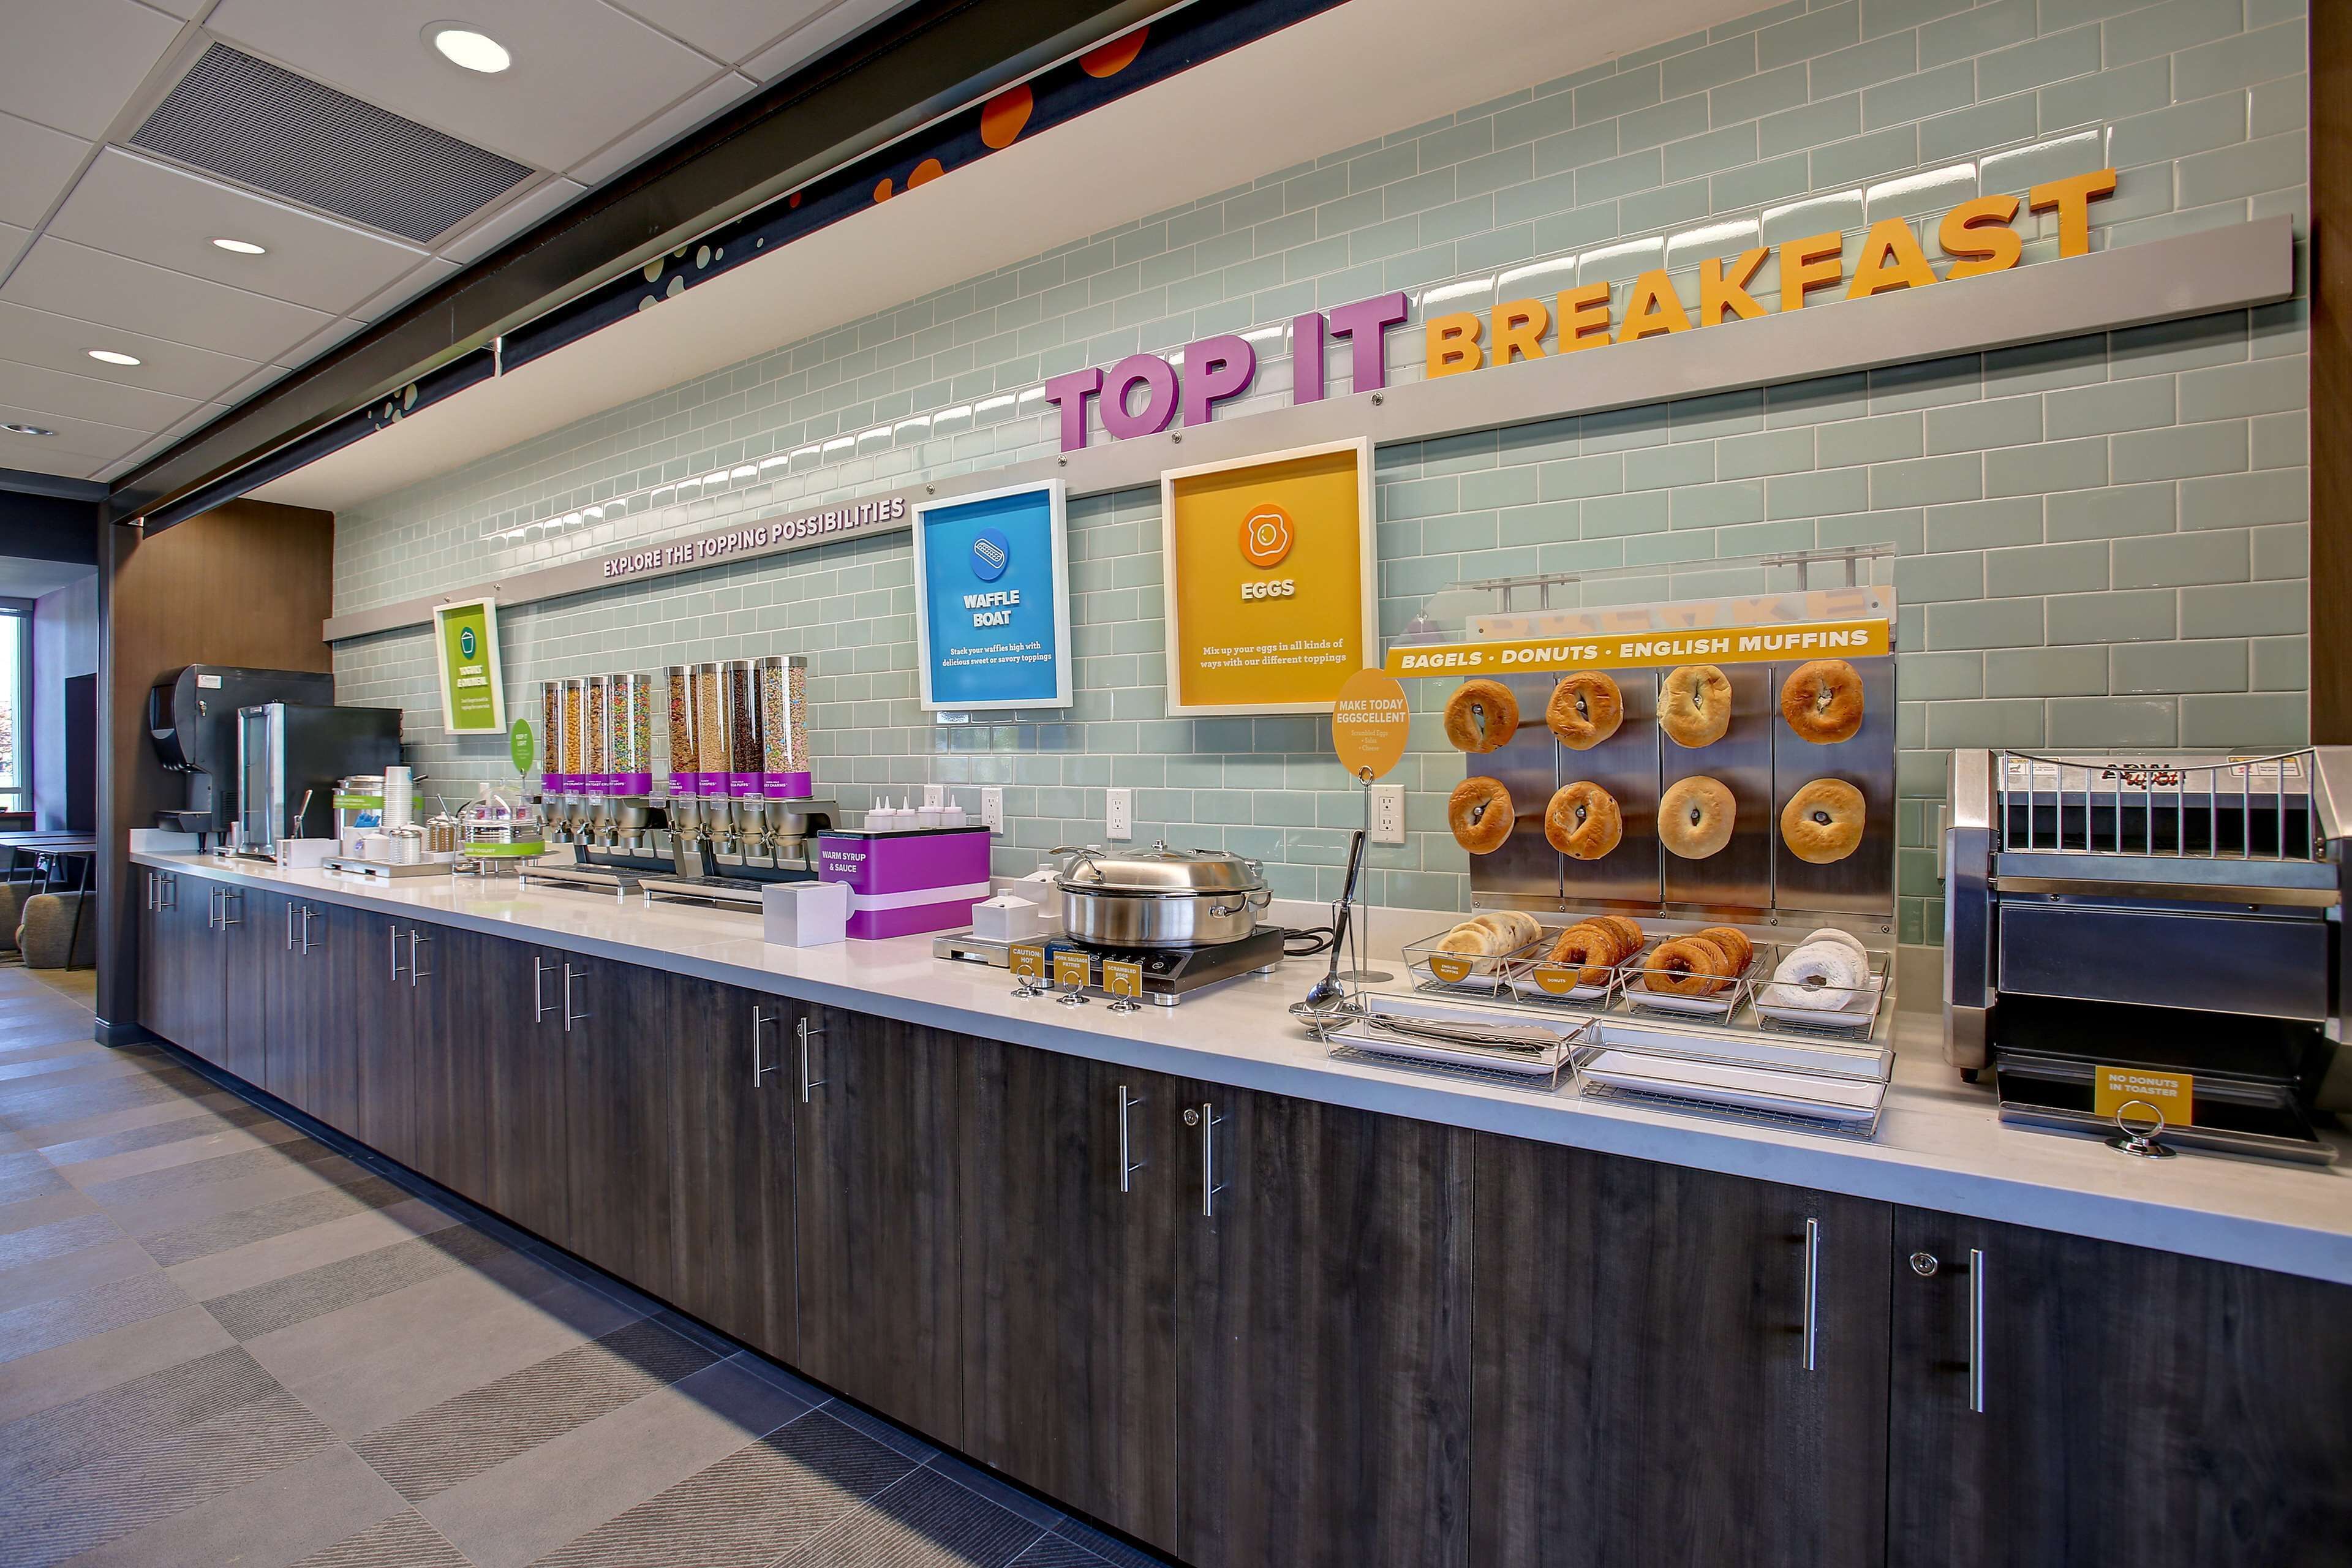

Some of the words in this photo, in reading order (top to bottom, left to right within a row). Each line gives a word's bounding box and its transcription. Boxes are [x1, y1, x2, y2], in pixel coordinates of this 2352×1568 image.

[1045, 334, 1256, 453] TOP
[1293, 291, 1408, 405] IT
[1425, 167, 2116, 379] BREAKFAST
[603, 549, 662, 577] EXPLORE
[666, 543, 694, 565] THE
[697, 527, 767, 557] TOPPING
[772, 497, 905, 543] POSSIBILITIES
[1241, 579, 1295, 600] EGGS
[963, 590, 1020, 609] WAFFLE
[973, 610, 1012, 628] BOAT
[950, 647, 968, 655] Stack
[984, 644, 1009, 654] waffles
[1009, 643, 1025, 652] high
[1025, 641, 1041, 650] with
[1202, 646, 1219, 655] Mix
[1221, 647, 1232, 656] up
[1234, 646, 1254, 656] your
[1256, 645, 1278, 655] eggs
[1278, 642, 1289, 651] in
[1290, 641, 1302, 650] all
[1303, 639, 1331, 649] kinds
[1332, 638, 1343, 647] of
[1401, 650, 1483, 669] BAGELS
[1501, 645, 1598, 664] DONUTS
[1619, 637, 1730, 658] ENGLISH
[1738, 629, 1869, 653] MUFFINS
[942, 657, 970, 666] delicious
[998, 655, 1020, 664] savory
[1021, 652, 1052, 662] toppings
[1200, 660, 1222, 669] ways
[1223, 657, 1243, 667] with
[1244, 657, 1260, 666] our
[1262, 655, 1303, 665] different
[1303, 653, 1347, 665] toppings
[1340, 700, 1367, 710] MAKE
[1369, 699, 1403, 710] TODAY
[1337, 712, 1406, 723] EGGSCELLENT
[822, 850, 842, 860] WARM
[842, 852, 866, 862] SYRUP
[829, 862, 834, 871] &
[835, 863, 857, 873] SAUCE
[1012, 948, 1041, 957] CAUTION:
[1107, 965, 1136, 974] SCRAMBLED
[2108, 1074, 2126, 1082] NO
[2128, 1076, 2179, 1088] DONUTS
[2124, 1085, 2178, 1097] TOASTER
